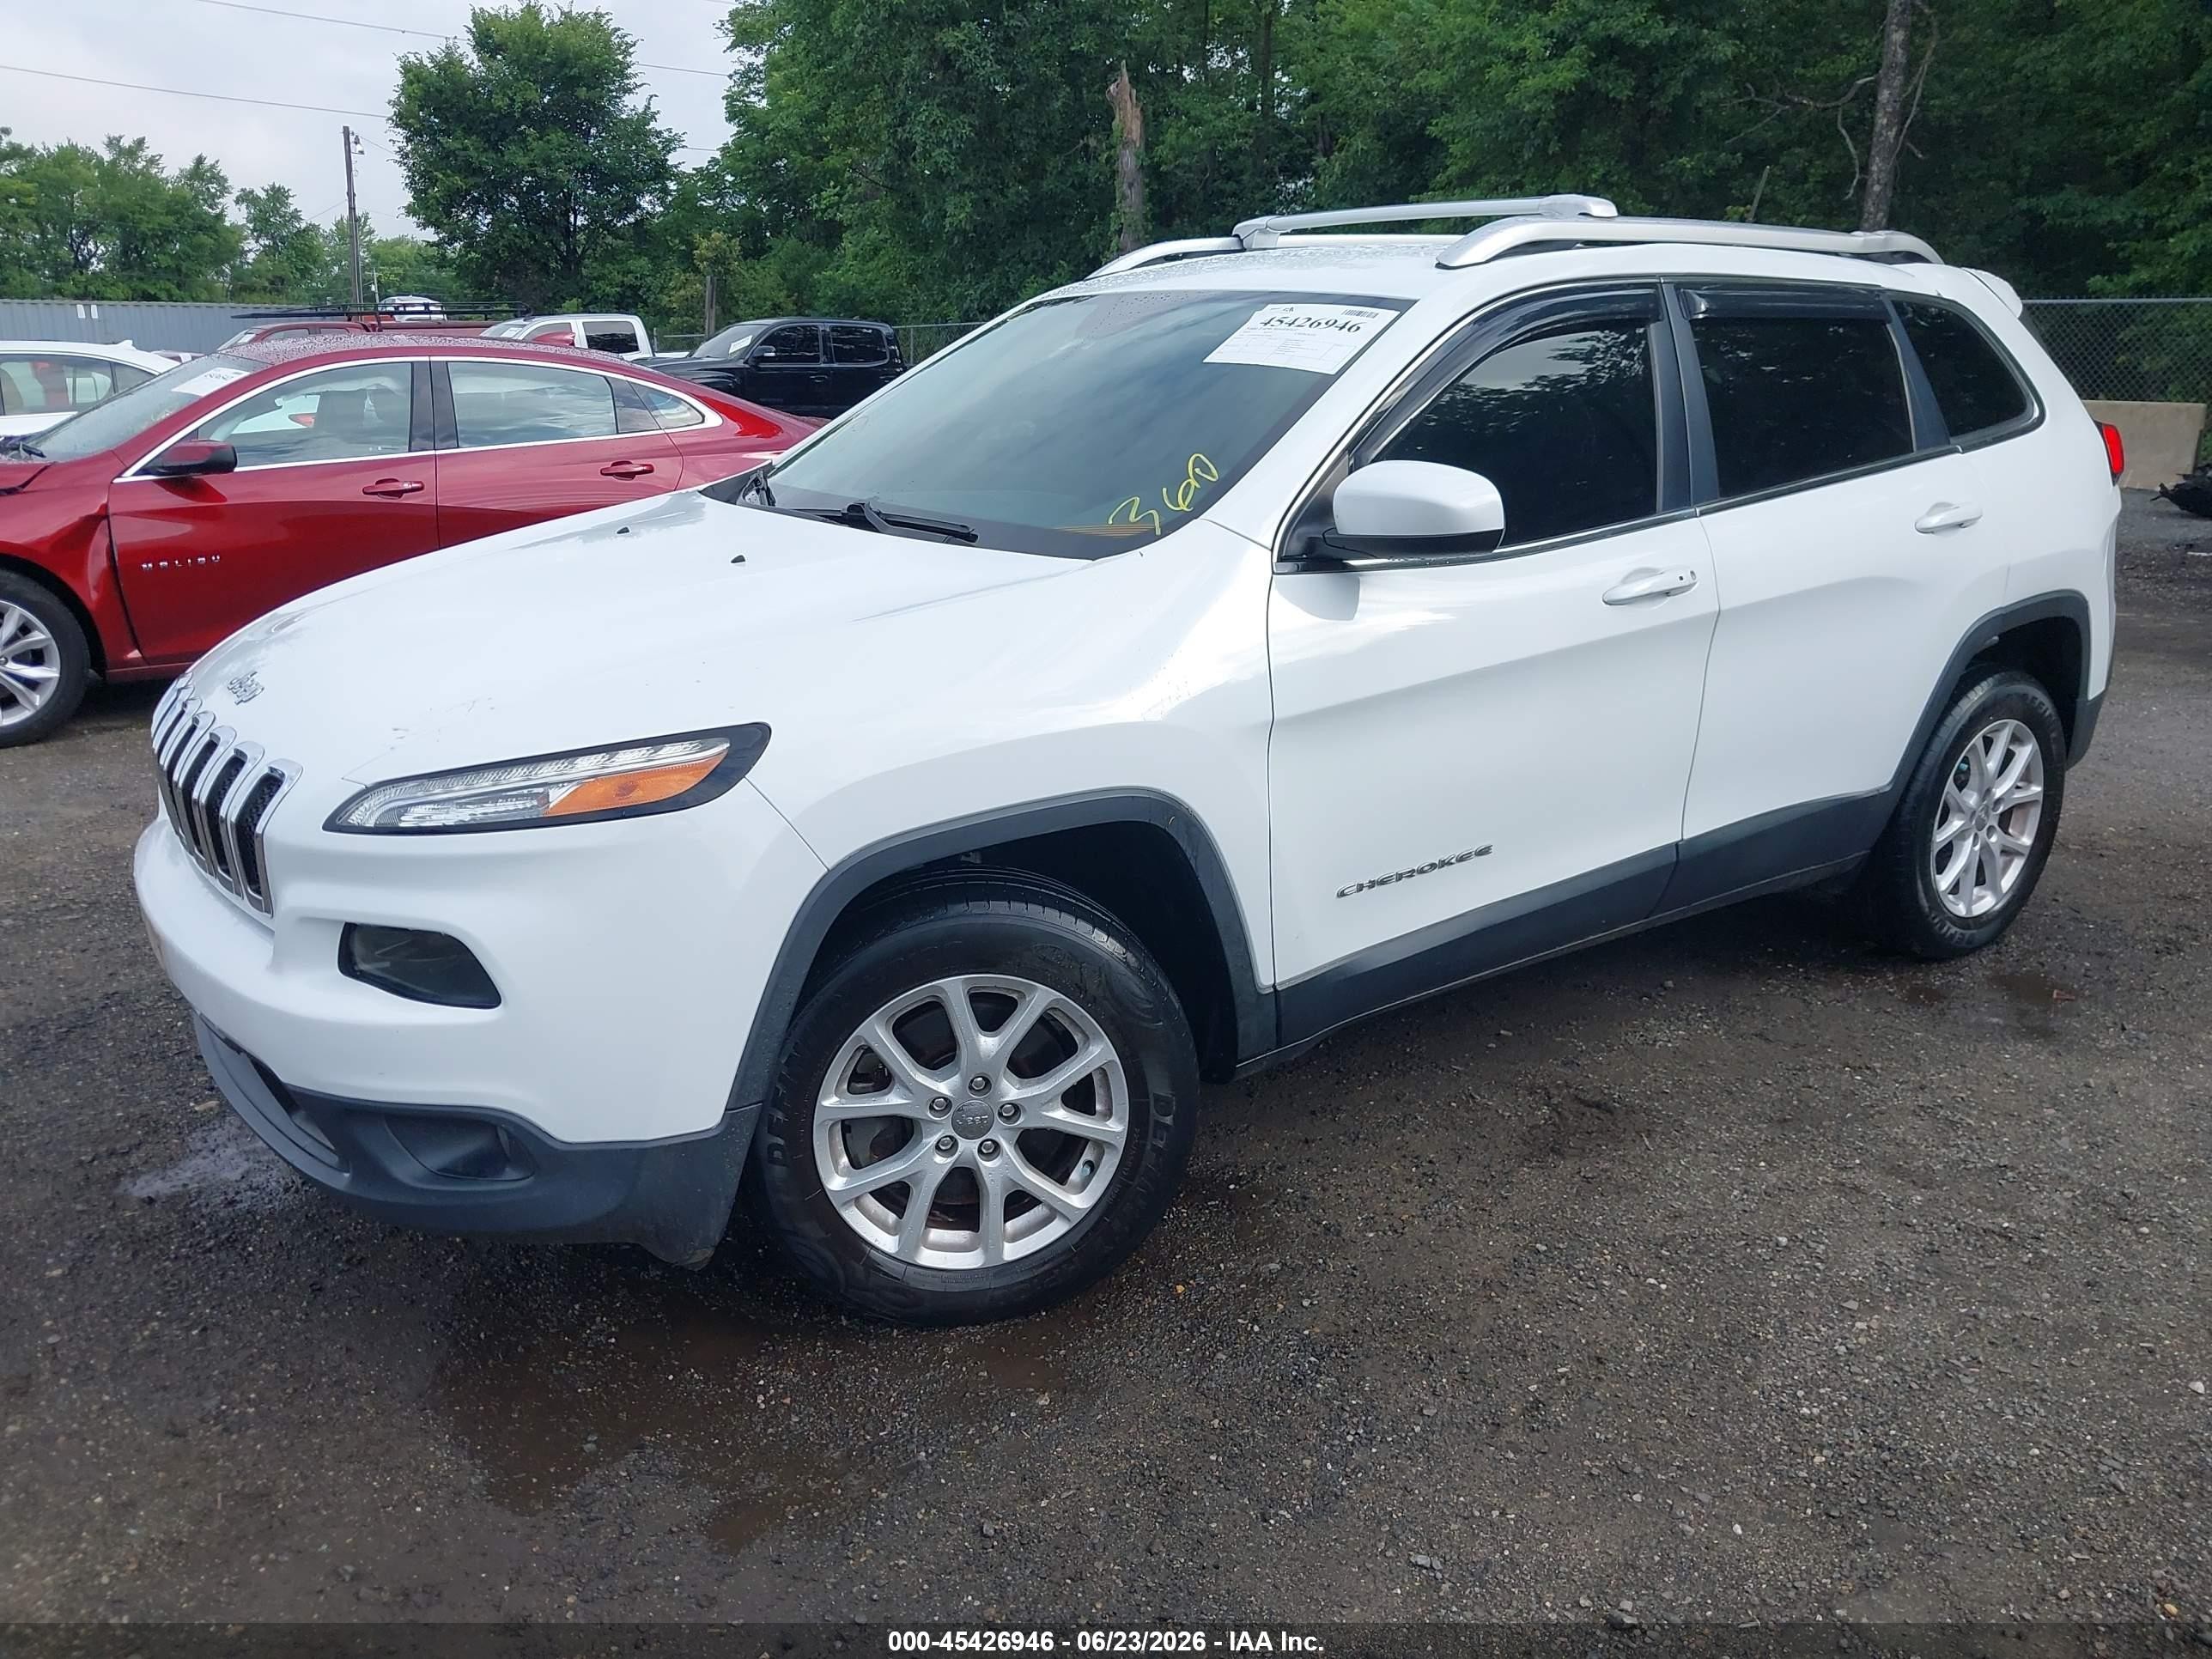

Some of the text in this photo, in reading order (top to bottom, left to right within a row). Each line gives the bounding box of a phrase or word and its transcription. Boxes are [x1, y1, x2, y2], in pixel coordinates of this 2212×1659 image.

[1260, 316, 1366, 333] 45426946
[141, 555, 221, 571] MALIBU
[1336, 844, 1493, 898] CHEROKEE
